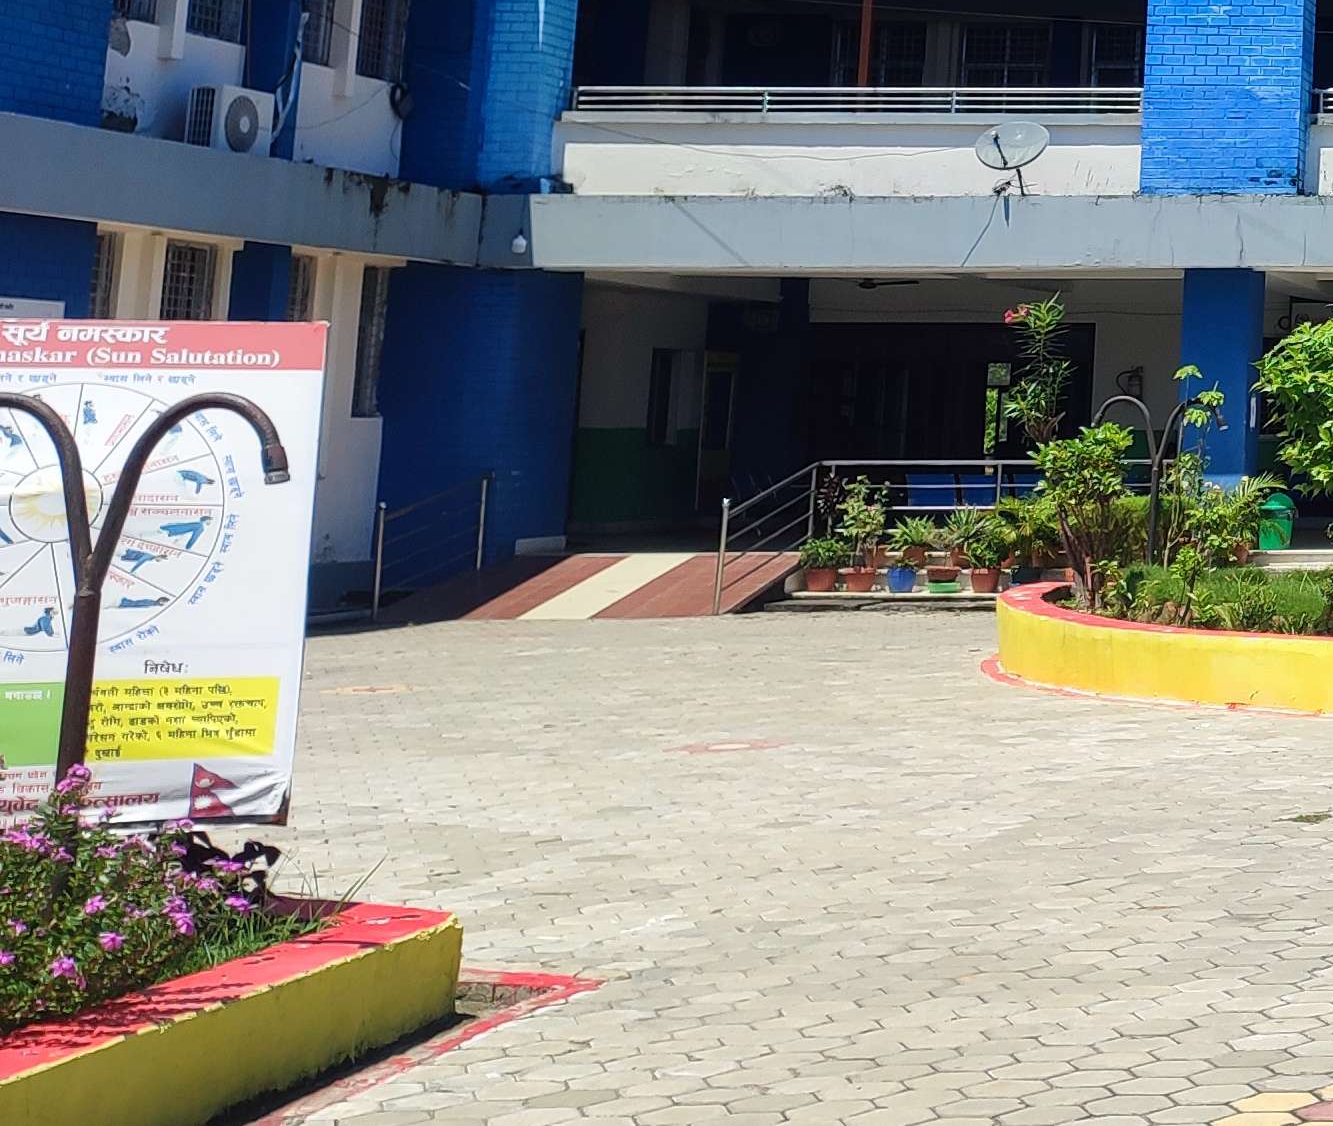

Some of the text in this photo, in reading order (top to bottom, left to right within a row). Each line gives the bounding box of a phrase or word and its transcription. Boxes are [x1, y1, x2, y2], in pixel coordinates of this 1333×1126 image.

[57, 326, 170, 344] नमस्कार
[86, 350, 141, 366] (Sun
[151, 348, 281, 367] Salutation)
